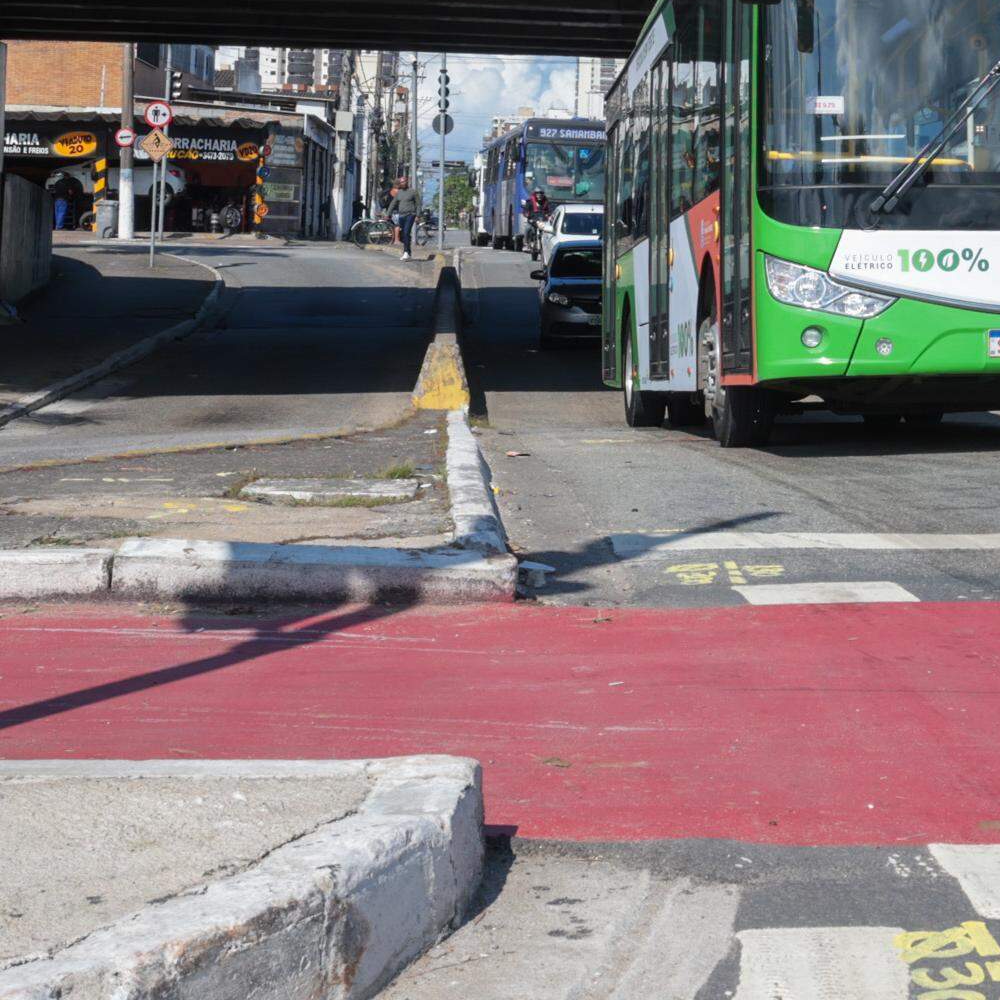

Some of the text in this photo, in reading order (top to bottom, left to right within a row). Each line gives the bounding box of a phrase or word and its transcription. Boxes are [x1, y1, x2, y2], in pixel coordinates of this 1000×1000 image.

[540, 128, 557, 137] 927
[28, 147, 49, 155] FREIOS
[69, 145, 84, 154] 20
[897, 247, 990, 272] 100%
